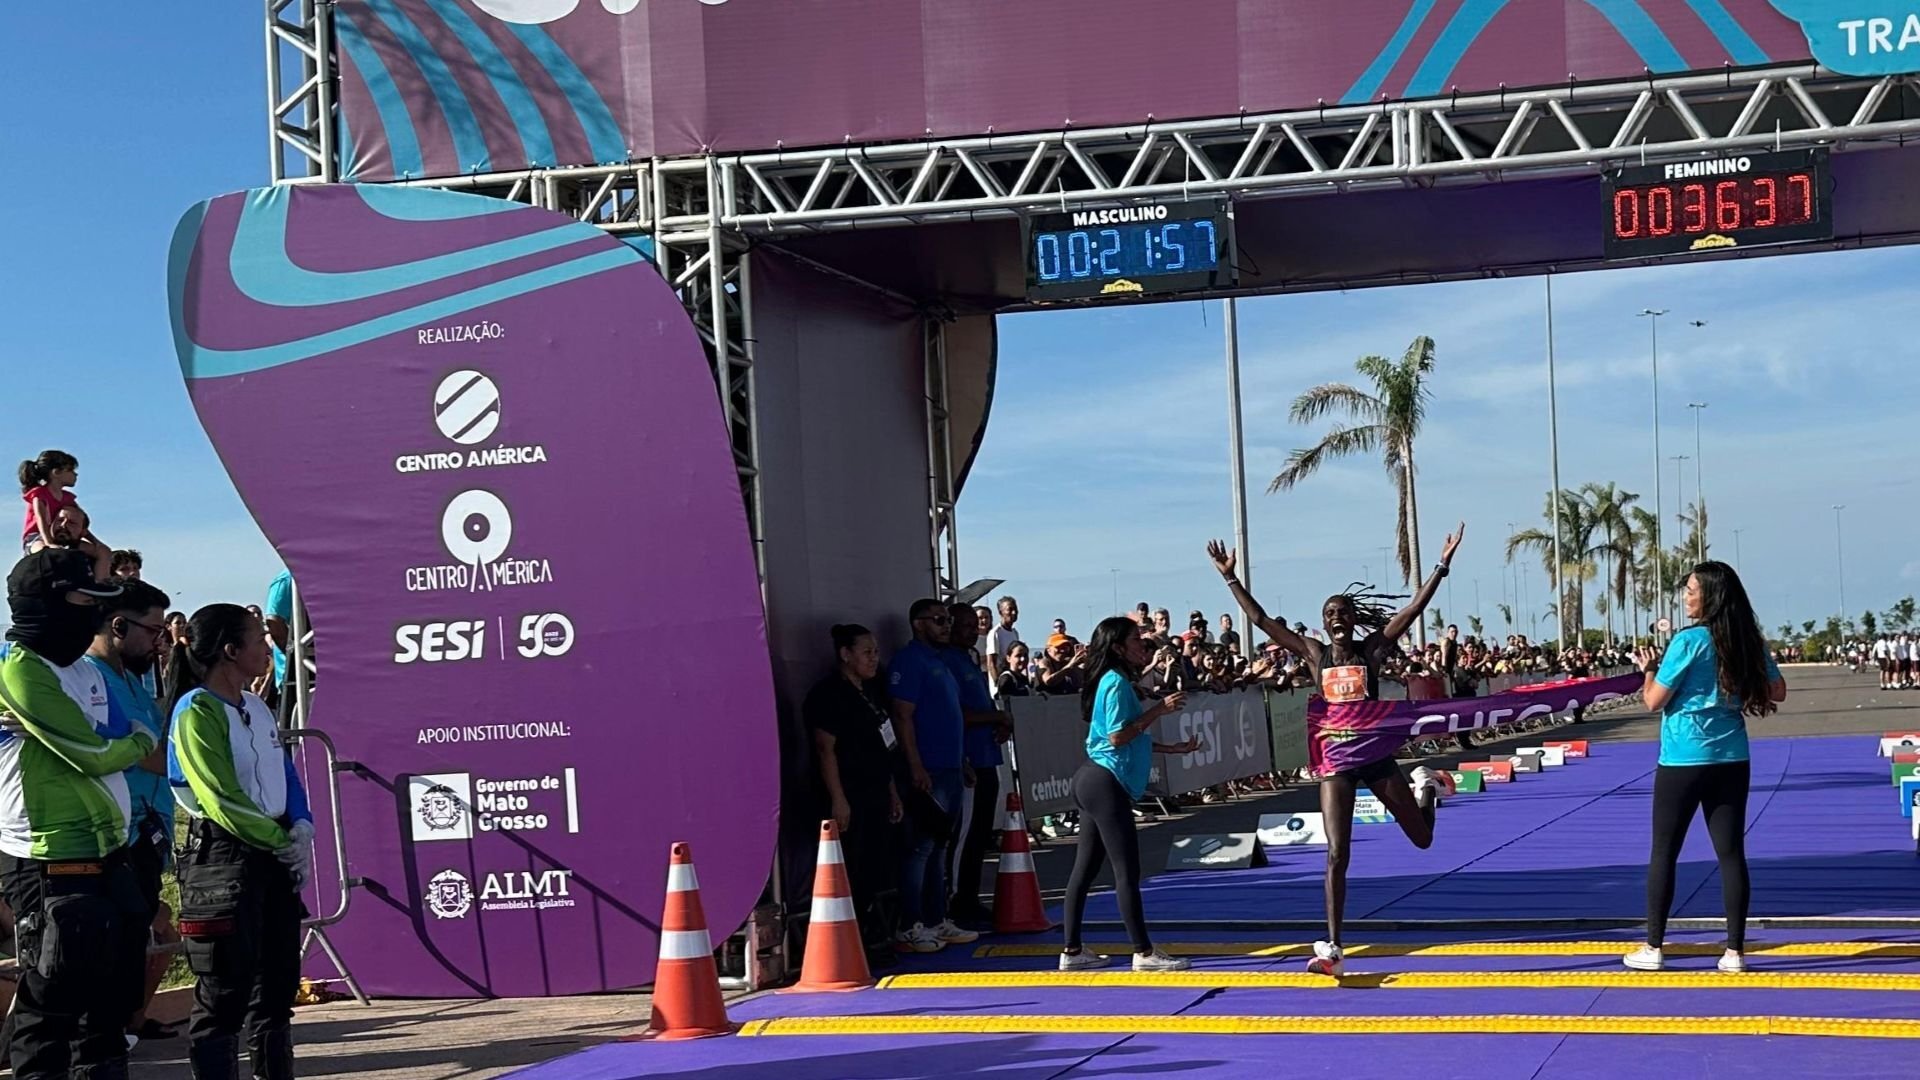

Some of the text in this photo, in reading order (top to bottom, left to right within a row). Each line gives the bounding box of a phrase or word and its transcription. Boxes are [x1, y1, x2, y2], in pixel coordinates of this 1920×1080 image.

[1664, 156, 1751, 180] FEMININO
[1072, 205, 1168, 227] MASCULINO
[418, 320, 505, 345] REALIZAÇÃO:
[395, 444, 547, 473] CENTRO AMÉRICA
[405, 564, 467, 591] CENTRO
[517, 612, 575, 658] 50
[417, 720, 571, 745] APOIO INSTITUCIONAL:
[476, 776, 560, 794] Governo de
[477, 793, 529, 812] Mato
[478, 811, 548, 832] Grosso
[479, 870, 573, 899] ALMT
[481, 899, 575, 910] Assembleia Legislativa
